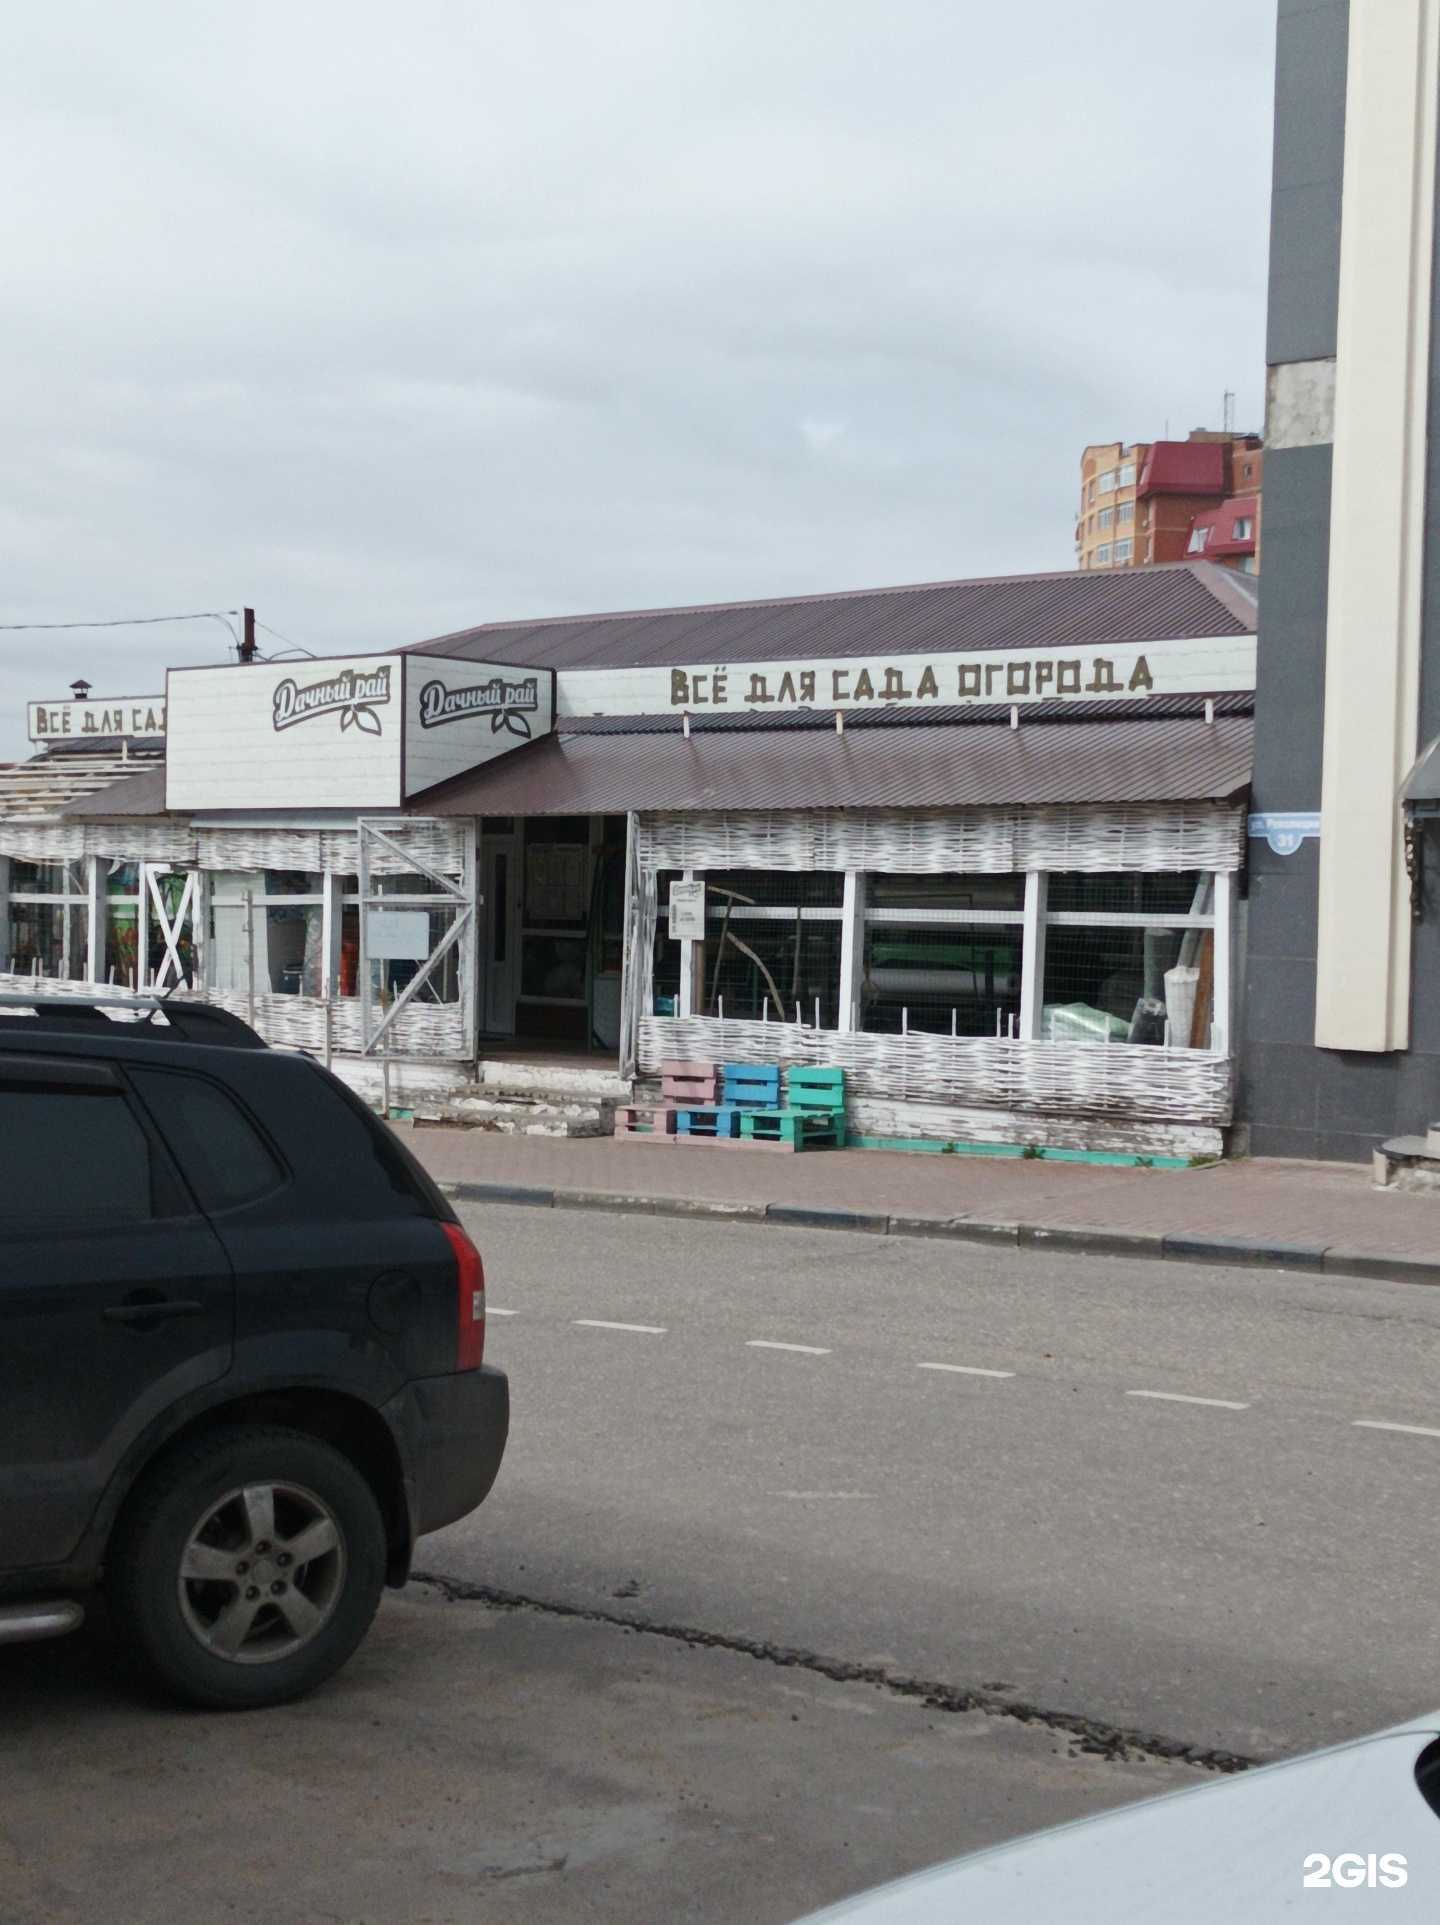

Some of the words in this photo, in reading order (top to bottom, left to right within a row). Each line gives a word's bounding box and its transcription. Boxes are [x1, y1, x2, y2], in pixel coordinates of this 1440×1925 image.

[275, 674, 352, 721] Дачный
[354, 670, 388, 705] рай
[422, 682, 502, 720] Дачный
[504, 681, 536, 709] рай
[744, 671, 815, 703] ДЛЯ
[832, 667, 938, 701] САДА
[958, 656, 1153, 696] ОГОРОДА
[81, 709, 123, 732] ДЛЯ
